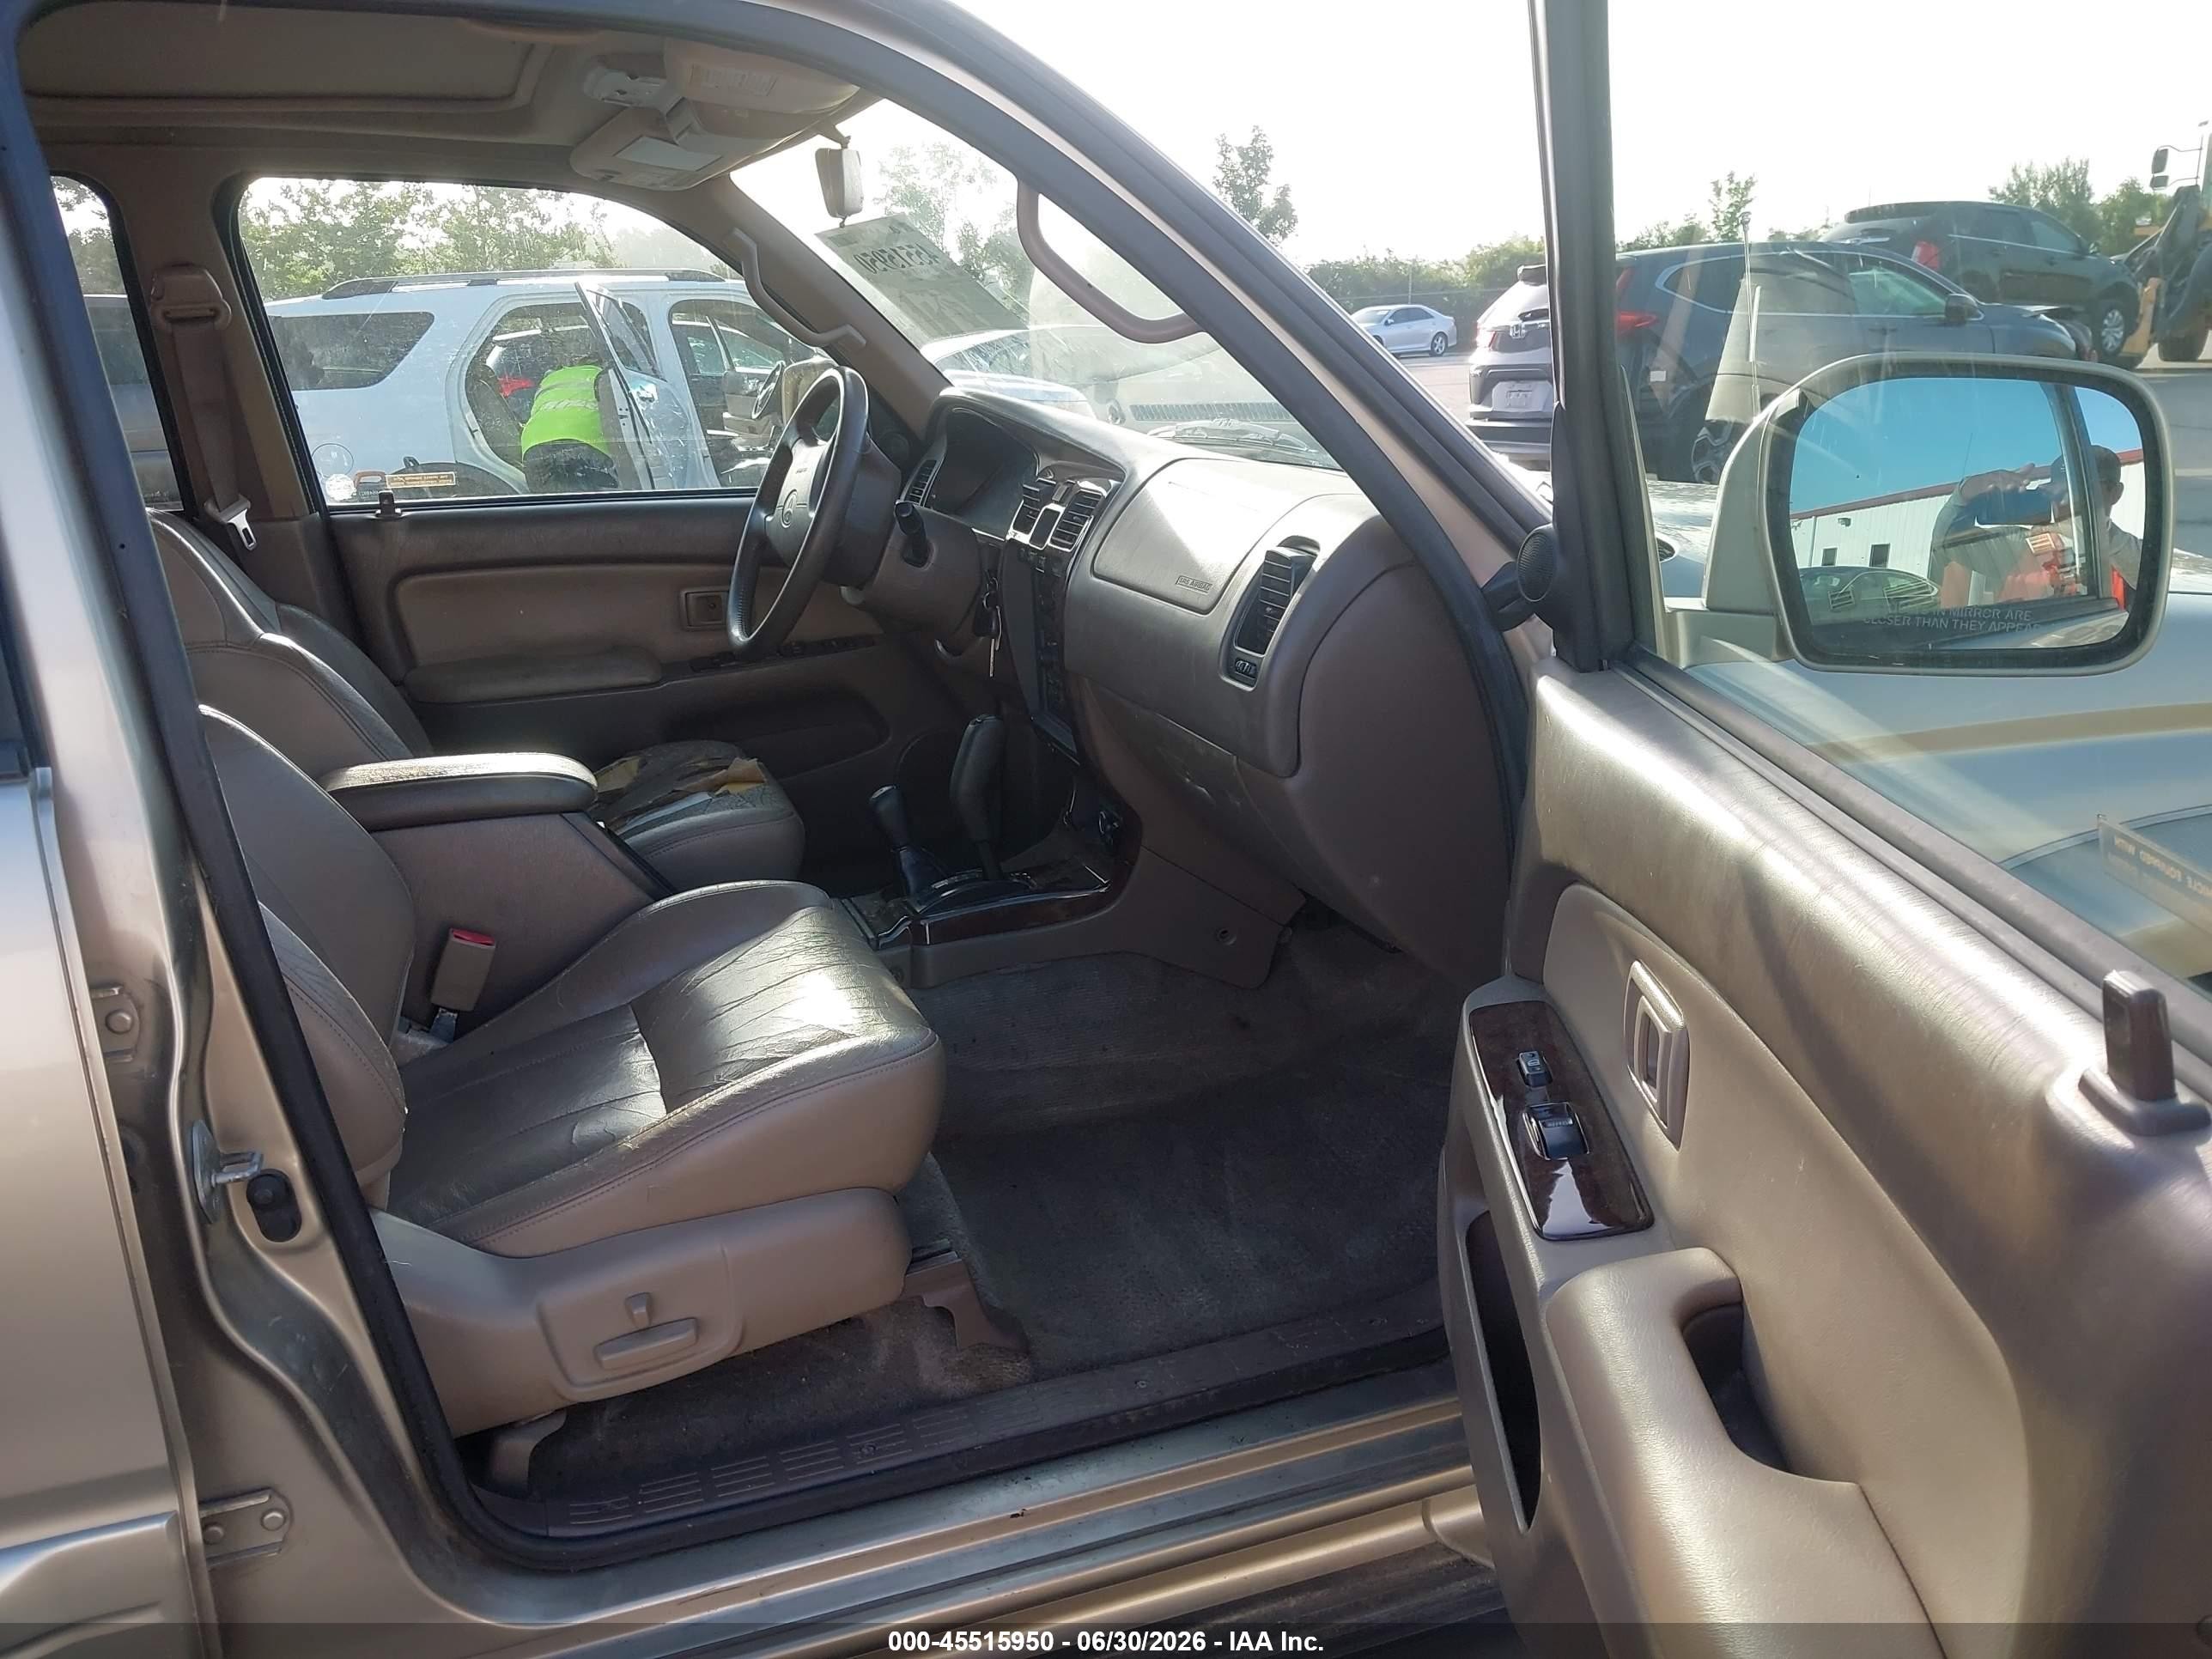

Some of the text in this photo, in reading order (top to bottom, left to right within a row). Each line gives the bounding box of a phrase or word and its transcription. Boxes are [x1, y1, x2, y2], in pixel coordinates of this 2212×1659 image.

[1190, 580, 1210, 591] AIRBAG
[1948, 606, 2001, 619] MIRROR
[2004, 609, 2033, 621] ARE
[1915, 616, 1948, 629] THAN
[1951, 618, 1985, 631] THEY
